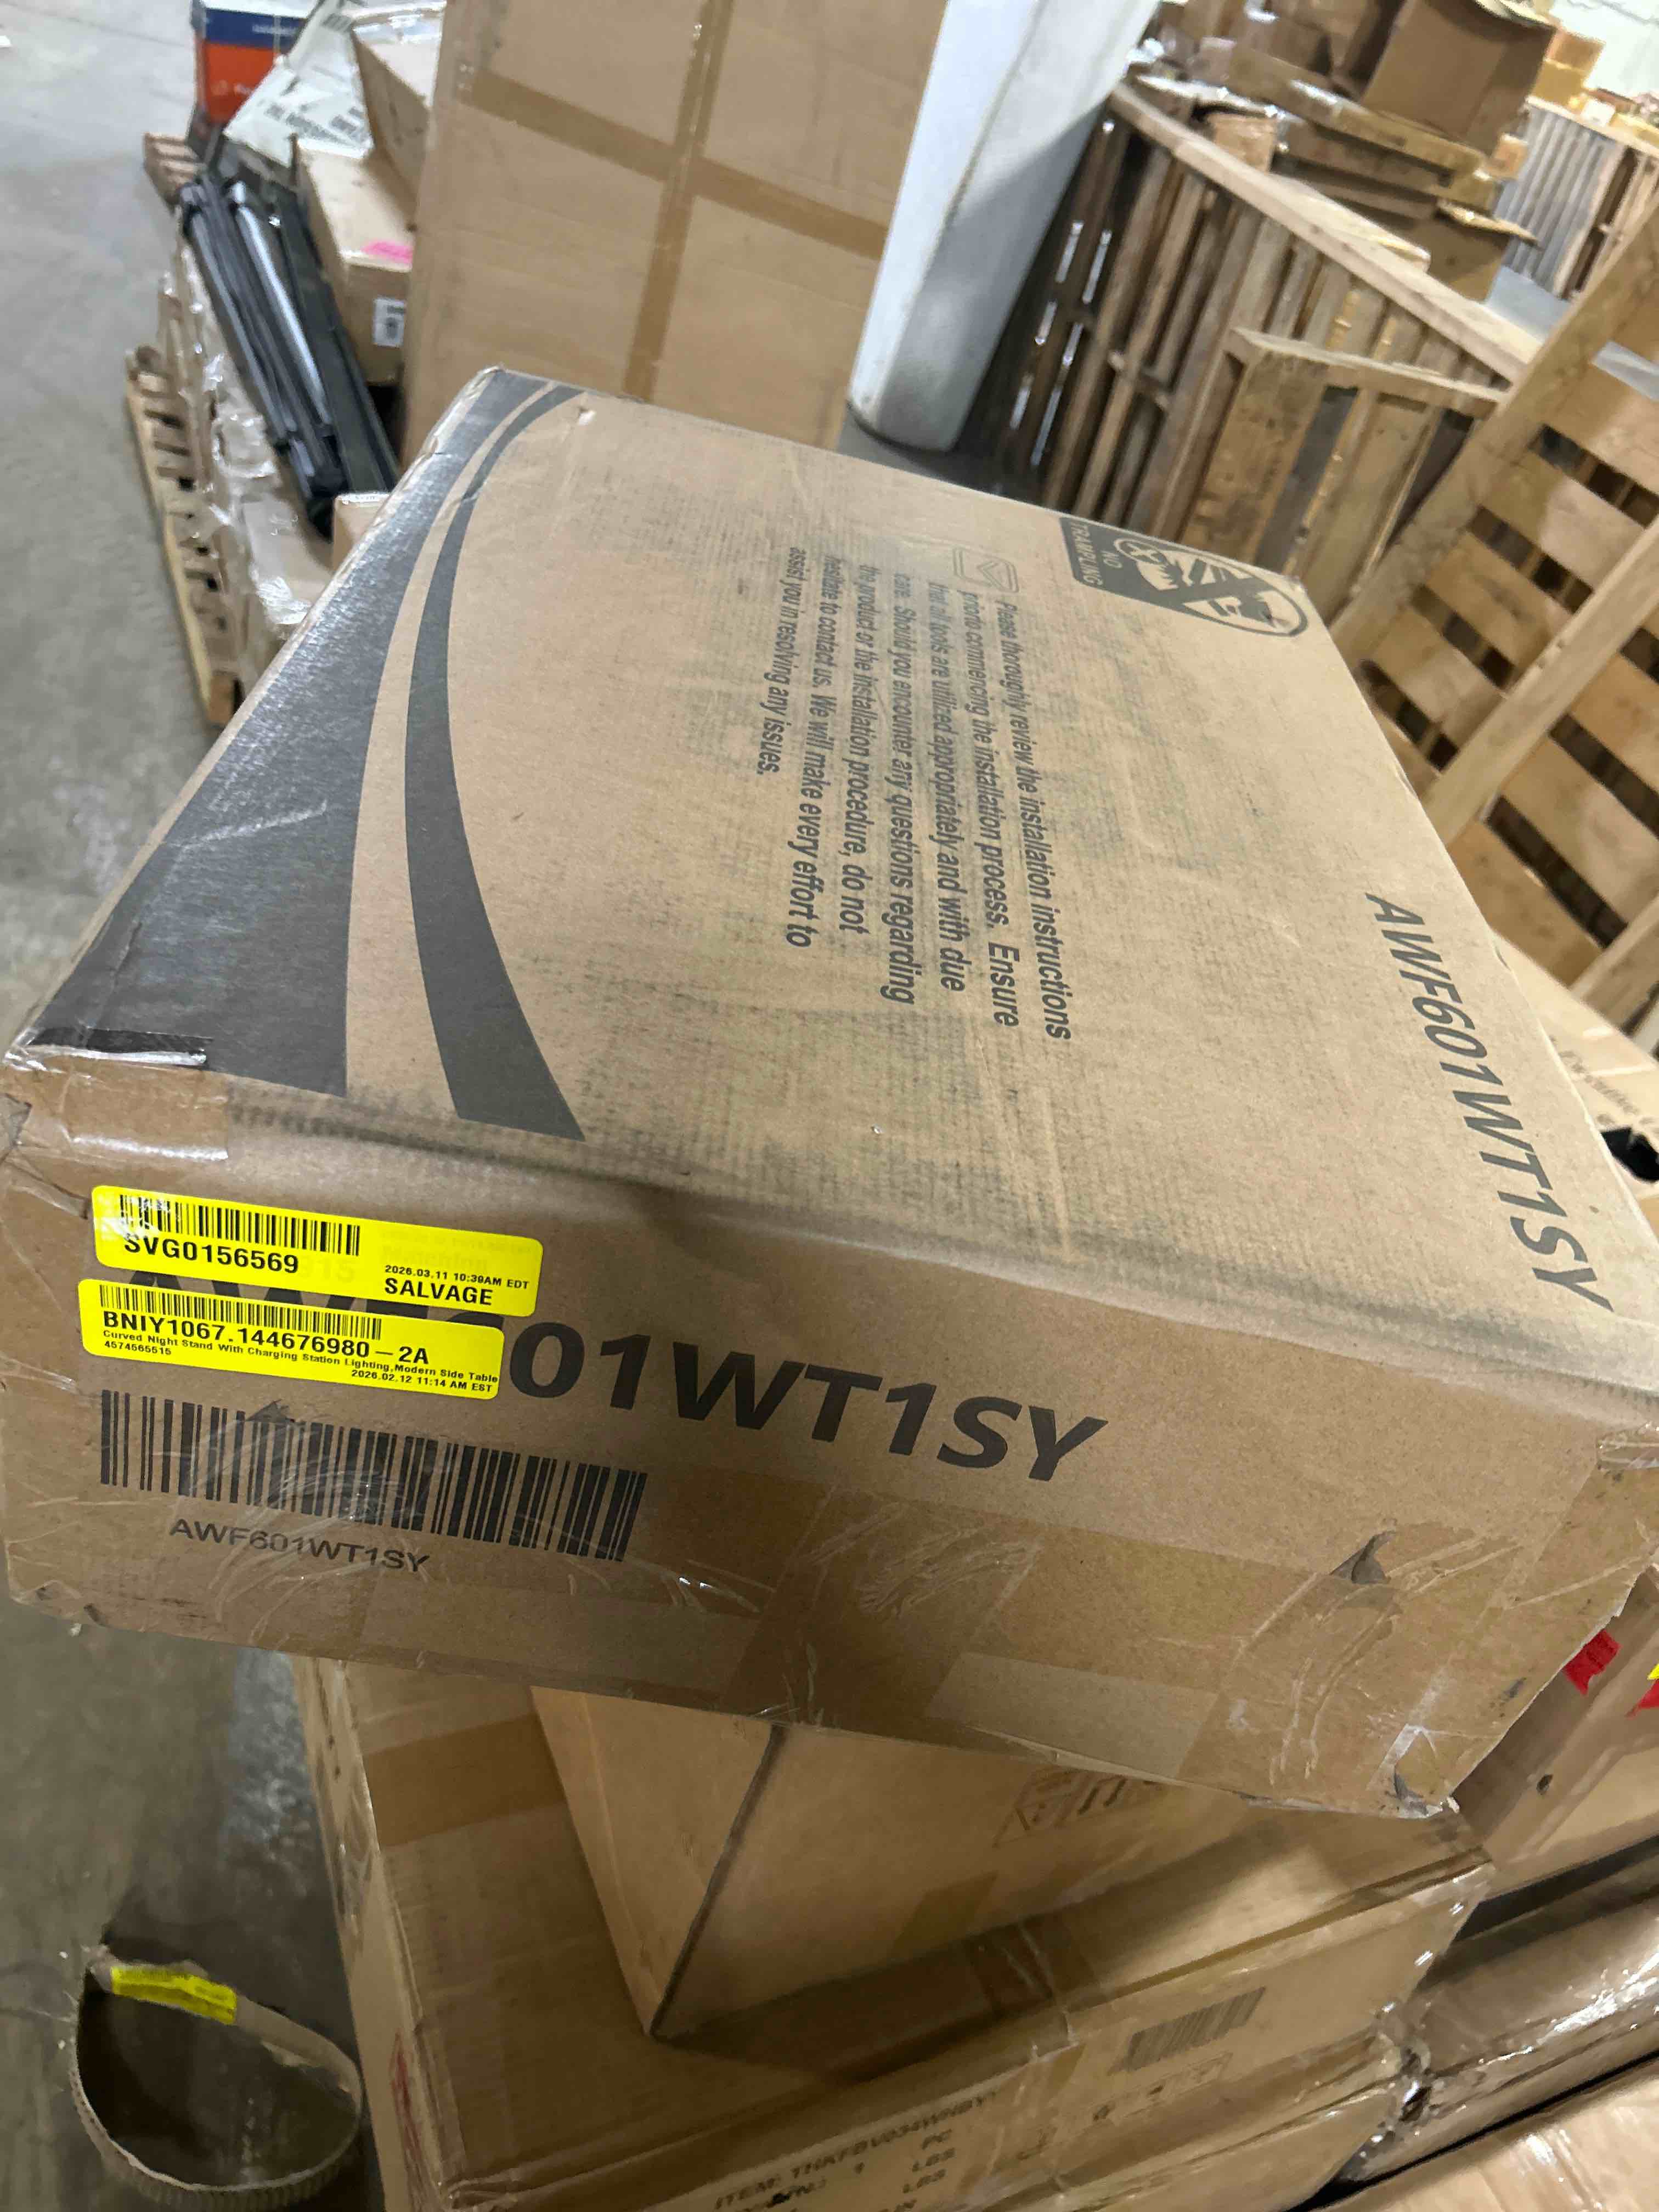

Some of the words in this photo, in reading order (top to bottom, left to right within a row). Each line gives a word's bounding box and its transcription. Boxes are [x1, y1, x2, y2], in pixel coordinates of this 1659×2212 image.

[786, 547, 810, 582] assist
[1070, 522, 1103, 585] TRAMPLING
[1101, 549, 1122, 568] NO
[780, 579, 804, 606] you
[822, 555, 845, 600] hesitate
[781, 606, 805, 619] in
[820, 602, 841, 614] to
[854, 582, 881, 631] product
[894, 605, 917, 651] Should
[995, 601, 1018, 638] Please
[764, 619, 800, 685] resolving
[815, 617, 839, 667] contact
[854, 649, 882, 670] the
[856, 632, 874, 648] or
[930, 623, 954, 654] tools
[888, 649, 913, 678] you
[932, 654, 950, 678] are
[964, 631, 995, 715] commencing
[1000, 640, 1032, 712] thoroughly
[759, 687, 789, 715] any
[810, 694, 837, 718] We
[850, 674, 878, 757] installation
[893, 680, 916, 757] encounter
[932, 680, 959, 735] utilized
[806, 721, 834, 751] will
[973, 719, 998, 743] the
[1009, 714, 1037, 765] review
[801, 751, 831, 799] make
[884, 758, 912, 791] any
[928, 735, 964, 850] appropriately
[974, 746, 1006, 840] installation
[1016, 766, 1042, 793] the
[838, 758, 874, 856] procedure,
[787, 803, 822, 859] every
[884, 794, 920, 889] questions
[1019, 797, 1056, 900] installation
[789, 861, 824, 920] effort
[842, 864, 872, 891] do
[937, 853, 968, 894] and
[786, 923, 820, 947] to
[839, 895, 871, 934] not
[938, 898, 970, 942] with
[880, 893, 922, 1005] regarding
[940, 947, 972, 991] due
[988, 942, 1020, 1026] Ensure
[1031, 904, 1073, 1040] instructions
[1365, 892, 1614, 1313] AWF601WT1SY
[124, 1232, 298, 1273] SVG0156569
[385, 1265, 448, 1279] 2026.03.11
[507, 1279, 530, 1289] EDT
[385, 1277, 493, 1306] SALVAGE
[103, 1330, 142, 1342] Curved
[148, 1335, 178, 1347] Night
[182, 1339, 213, 1351] Stand
[218, 1344, 243, 1354] With
[247, 1347, 298, 1361] Charging
[302, 1353, 340, 1365] Station
[440, 1369, 464, 1380] Side
[469, 1372, 499, 1383] Table
[352, 1369, 412, 1384] 2026.02.12
[417, 1377, 446, 1387] 11:14
[450, 1380, 467, 1390] AM
[471, 1383, 493, 1392] EST
[169, 1518, 430, 1573] AWF601WT1SY
